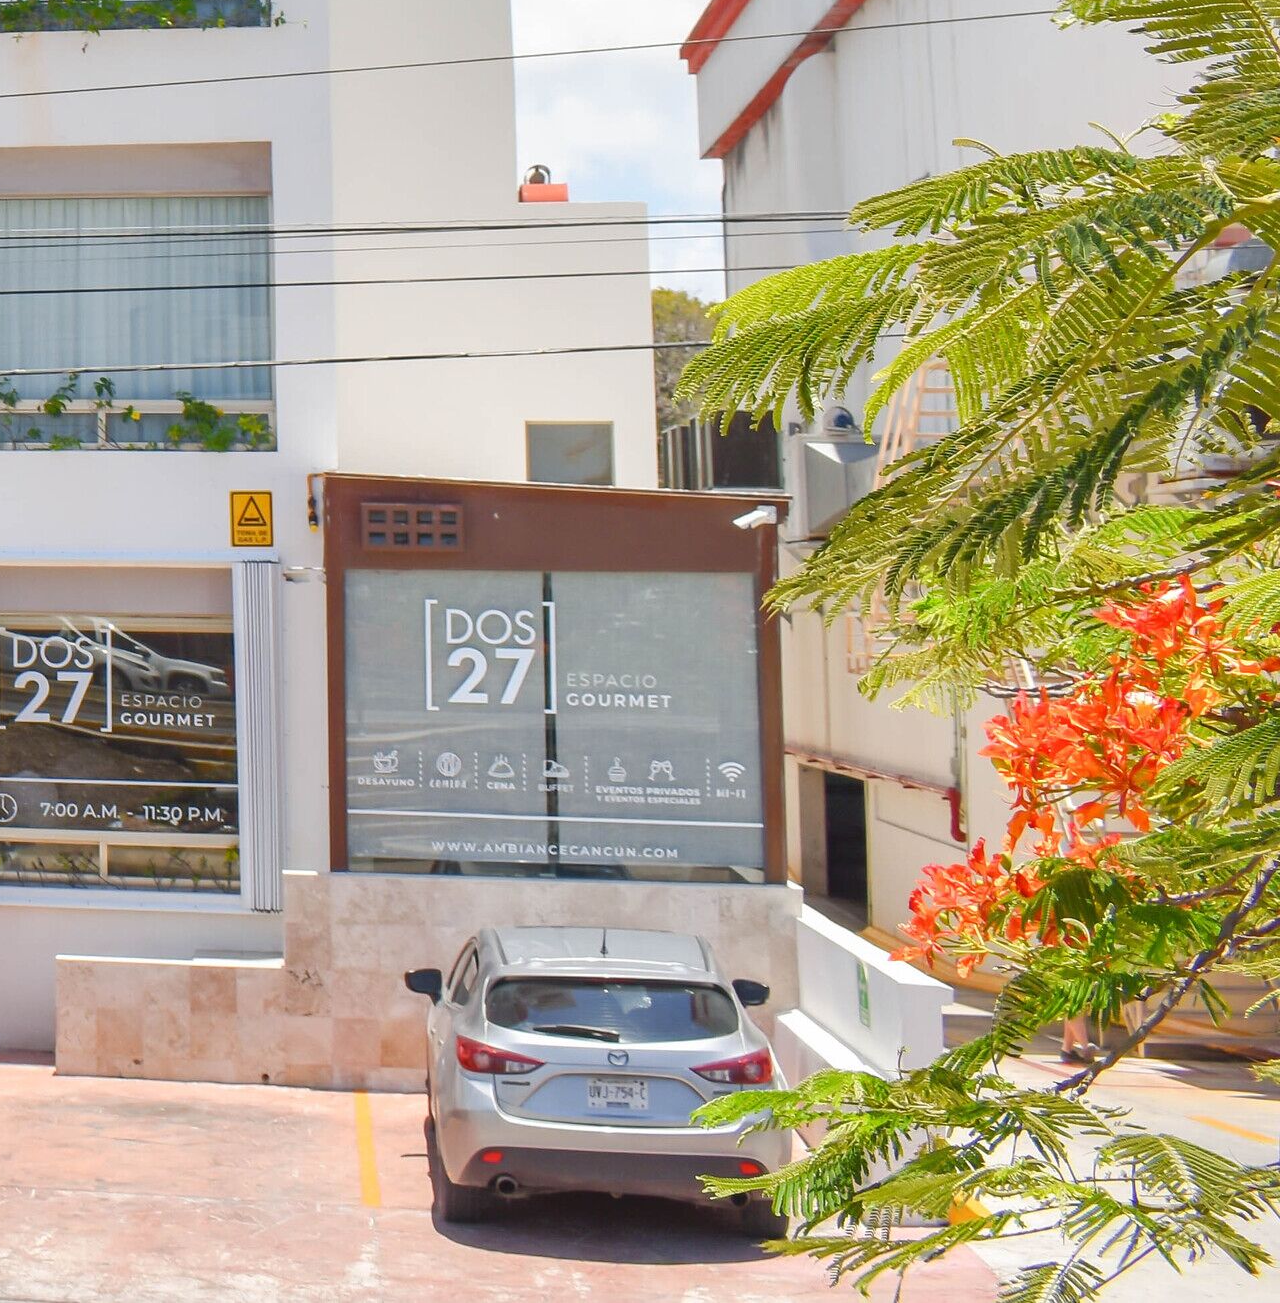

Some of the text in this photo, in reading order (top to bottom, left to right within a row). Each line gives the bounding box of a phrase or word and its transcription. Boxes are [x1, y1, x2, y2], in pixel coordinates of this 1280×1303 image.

[446, 608, 537, 646] DOS
[12, 635, 95, 669] DOS
[447, 647, 537, 705] 27
[566, 672, 658, 689] ESPACIO
[13, 670, 94, 725] 27
[120, 694, 203, 709] ESPACIO
[565, 692, 673, 709] GOURMET
[119, 711, 216, 728] GOURMET
[357, 777, 416, 788] DESAYUNO
[486, 780, 517, 791] CENA
[595, 785, 701, 797] EVENTOS PRIVADOS
[604, 795, 646, 804] EVENTOS
[647, 796, 701, 806] ESPECIALES
[40, 802, 79, 818] 7:00
[83, 803, 122, 819] A.M.
[143, 805, 183, 822] 11:30
[188, 807, 225, 823] P.M.
[431, 841, 679, 859] WWW.AMBIANCECANCUN.COM
